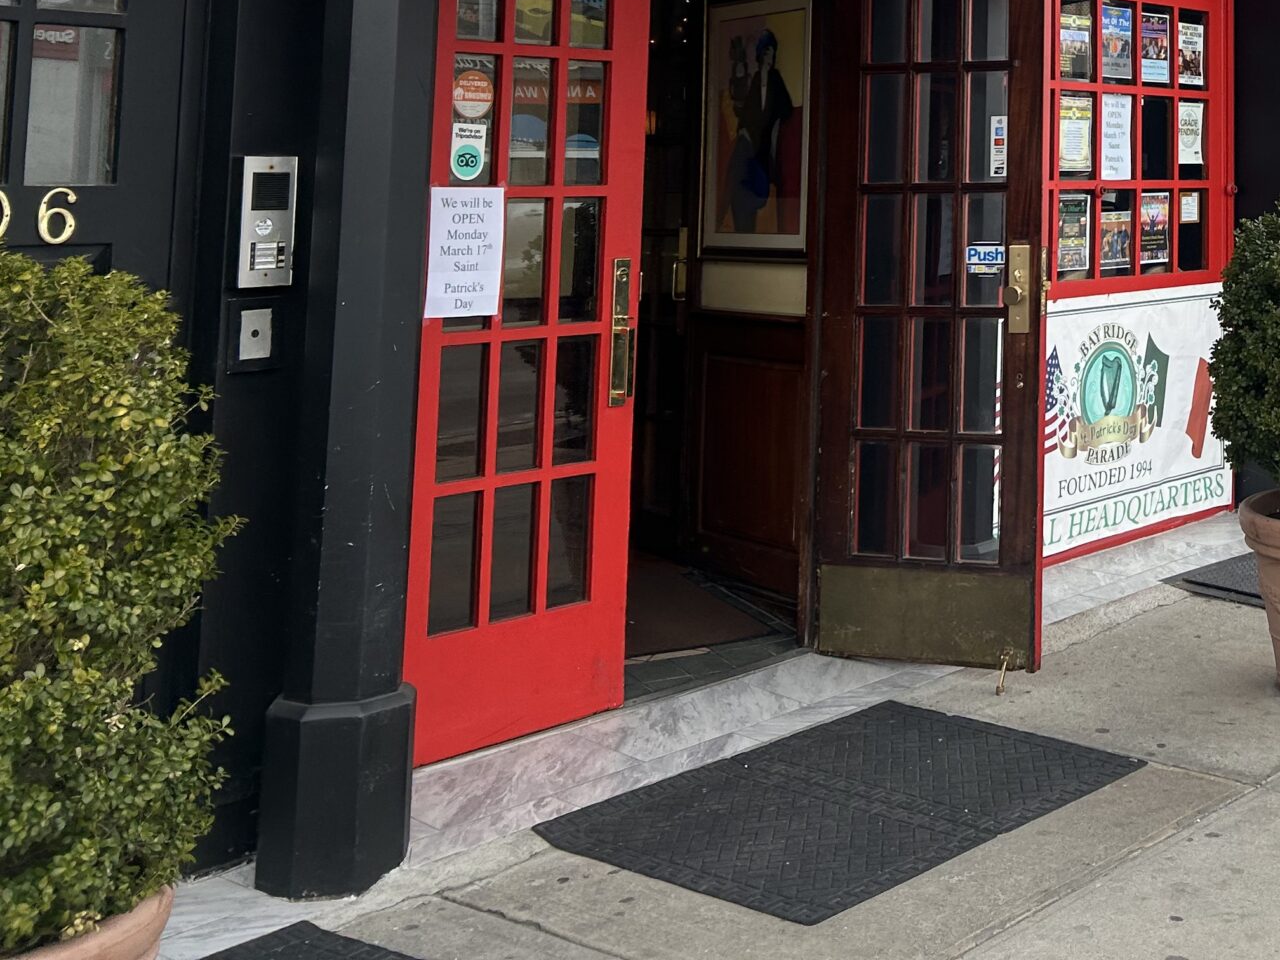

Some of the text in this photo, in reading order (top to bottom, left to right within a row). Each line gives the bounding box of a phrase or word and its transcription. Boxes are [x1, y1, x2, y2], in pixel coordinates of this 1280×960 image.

[1180, 118, 1198, 127] GRADE
[1178, 127, 1200, 137] PENDING
[441, 197, 493, 208] We will be
[452, 213, 485, 224] OPEN
[447, 228, 489, 242] Monday
[440, 245, 473, 256] March
[967, 247, 1005, 262] Push
[453, 261, 479, 272] Saint
[444, 282, 484, 294] Patrick's
[454, 298, 474, 311] Day
[1080, 324, 1136, 358] BAY RIDGE
[1086, 442, 1130, 464] PARADE
[1057, 458, 1153, 498] FOUNDED 1994
[1067, 472, 1225, 539] HEADQUARTERS
